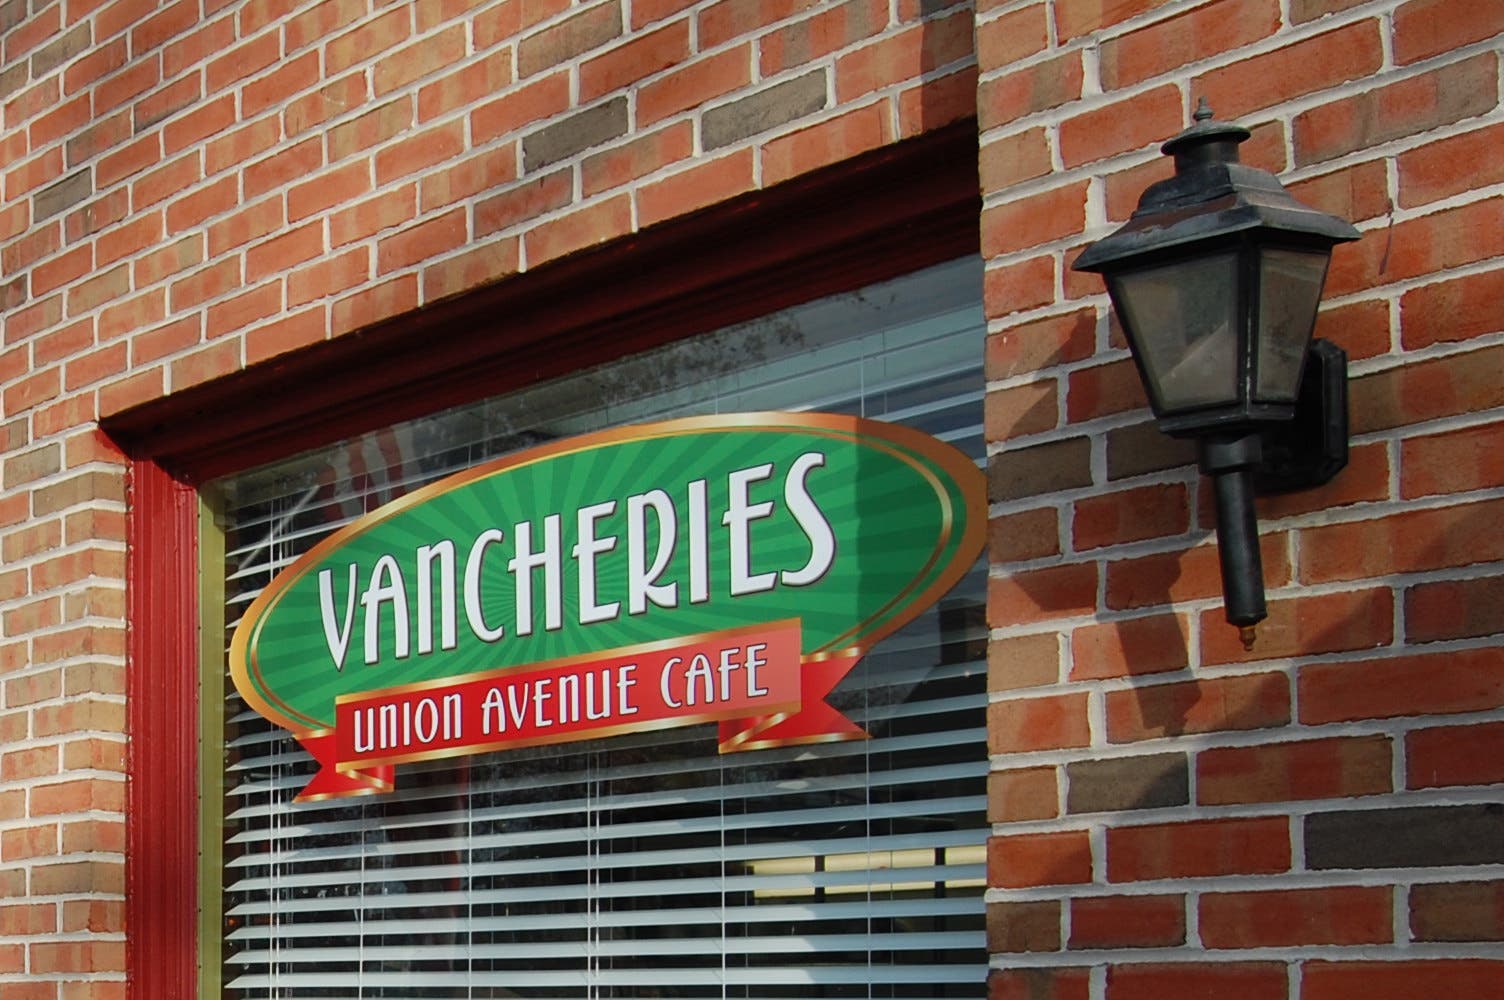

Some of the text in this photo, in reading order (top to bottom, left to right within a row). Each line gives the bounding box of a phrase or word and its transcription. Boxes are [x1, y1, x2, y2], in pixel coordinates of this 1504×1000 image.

[317, 451, 837, 672] VANCHERIES
[352, 642, 769, 754] UNION AVENUE CAFE
